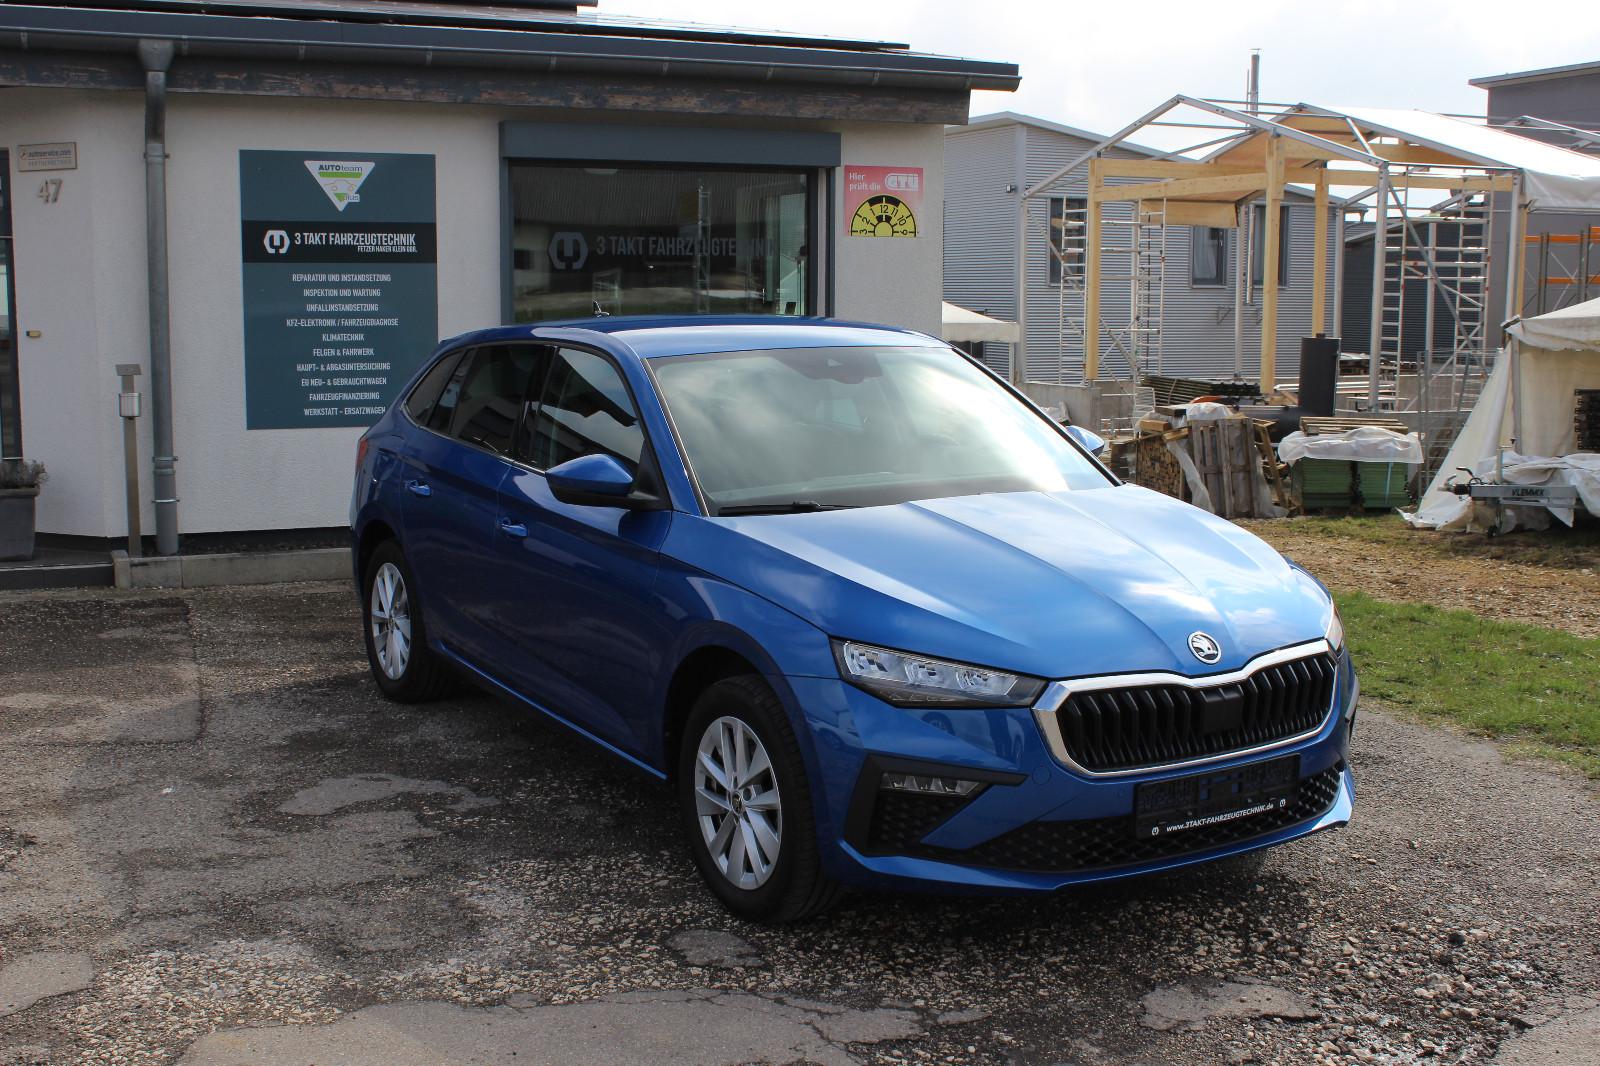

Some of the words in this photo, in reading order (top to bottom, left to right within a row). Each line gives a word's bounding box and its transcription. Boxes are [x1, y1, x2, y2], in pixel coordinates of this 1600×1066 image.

[849, 172, 865, 181] Hier
[37, 179, 63, 204] 47
[849, 182, 868, 192] prüft
[869, 183, 881, 191] die
[861, 216, 871, 225] 2
[880, 205, 888, 214] 12
[891, 207, 899, 217] 11
[897, 215, 907, 226] 10
[294, 232, 301, 245] 3
[303, 232, 328, 245] TAKT
[329, 233, 416, 246] FAHRZEUGTECHNIK
[596, 236, 605, 256] 3
[610, 236, 646, 256] TAKT
[292, 274, 327, 282] REPARATUR
[327, 274, 340, 282] UND
[341, 274, 391, 282] INSTANDSETZUNG
[303, 289, 338, 297] INSPEKTION
[339, 289, 352, 297] UND
[352, 289, 381, 297] WARTUNG
[306, 304, 379, 312] UNFALLINSTANDSETZUNG
[286, 319, 336, 327] KFZ-ELEKTRONIK
[341, 318, 398, 326] FAHRZEUGDIAGNOSE
[322, 333, 364, 342] KLIMATECHNIK
[313, 348, 335, 357] FELGEN
[342, 348, 374, 356] FAHRWERK
[297, 363, 319, 371] HAUPT-
[326, 363, 391, 371] ABGASUNTERSUCHUNG
[301, 378, 309, 387] EU
[310, 378, 326, 386] NEU-
[332, 377, 387, 386] GEBRAUCHTWAGEN
[309, 392, 380, 401] FAHRZEUGFINANZIERUNG
[303, 407, 339, 416] WERKSTATT
[344, 406, 386, 415] ERSATZWAGEN
[1166, 802, 1274, 832] www.3TAKT-FAHRZEUGTECHNIK.de
